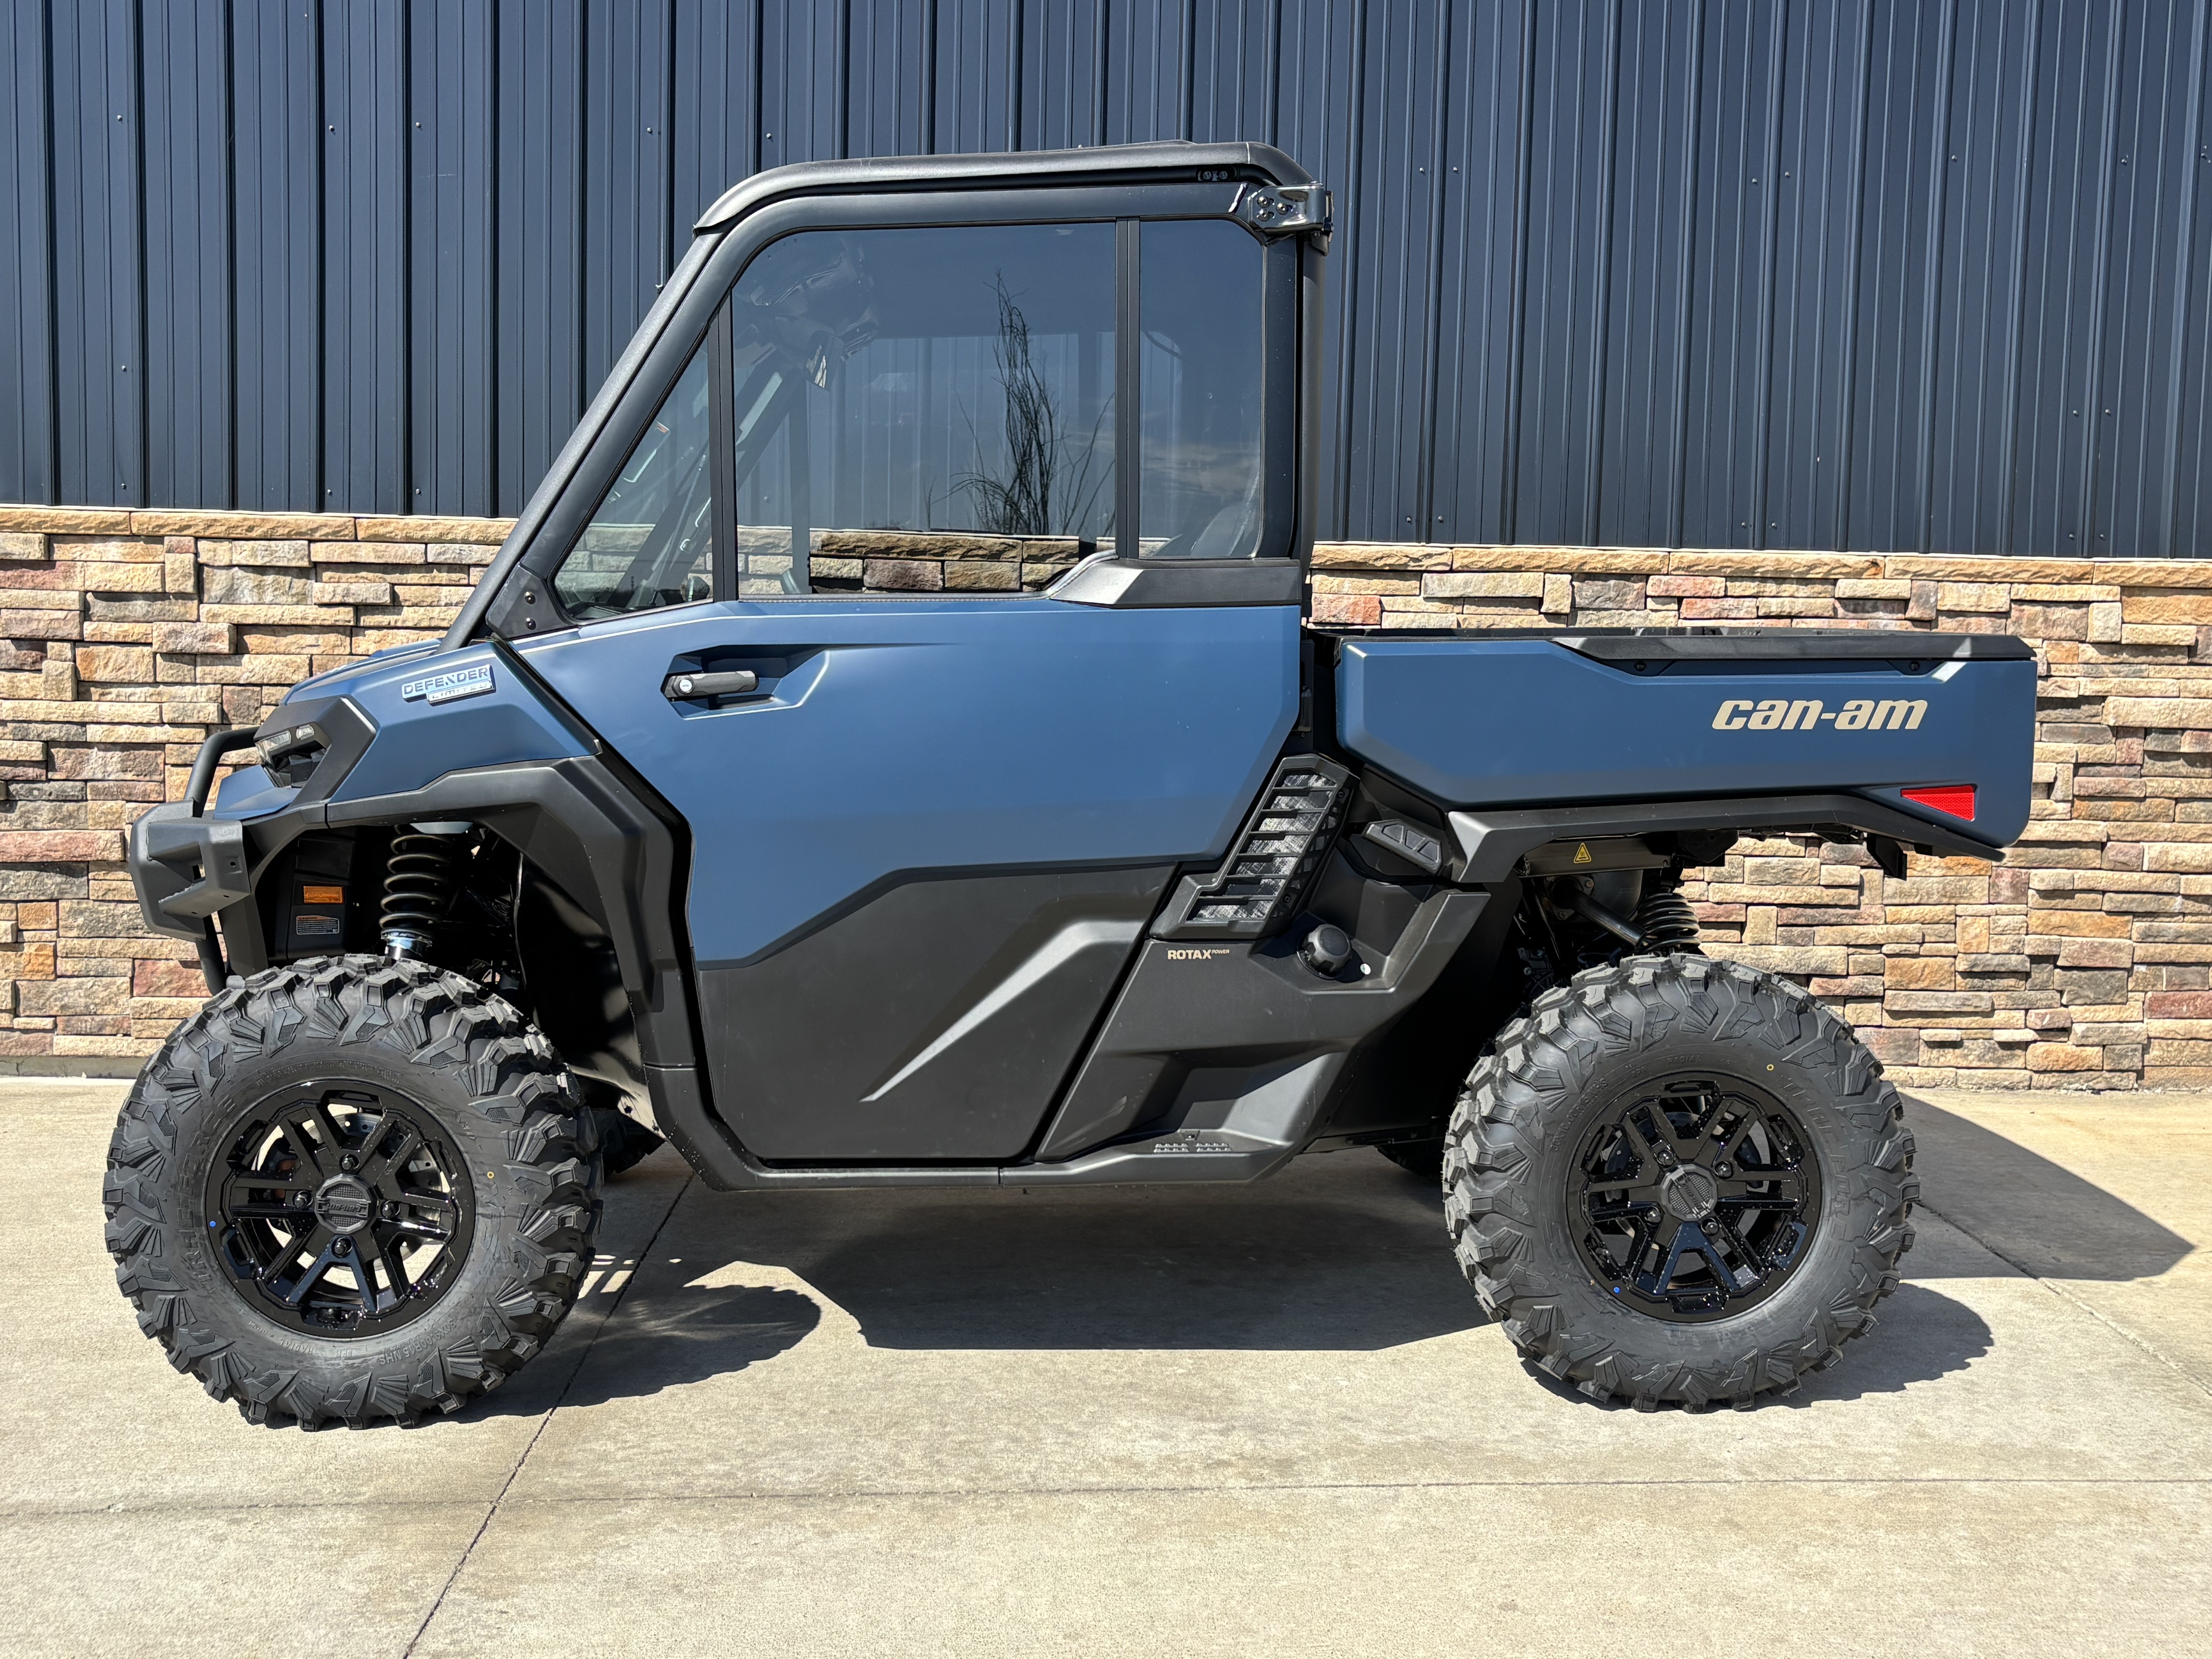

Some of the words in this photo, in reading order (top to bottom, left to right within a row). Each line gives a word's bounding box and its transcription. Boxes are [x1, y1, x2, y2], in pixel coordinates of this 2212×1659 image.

[404, 668, 488, 694] DEFENDER
[1712, 700, 1928, 729] can-am
[1168, 950, 1212, 960] ROTAX
